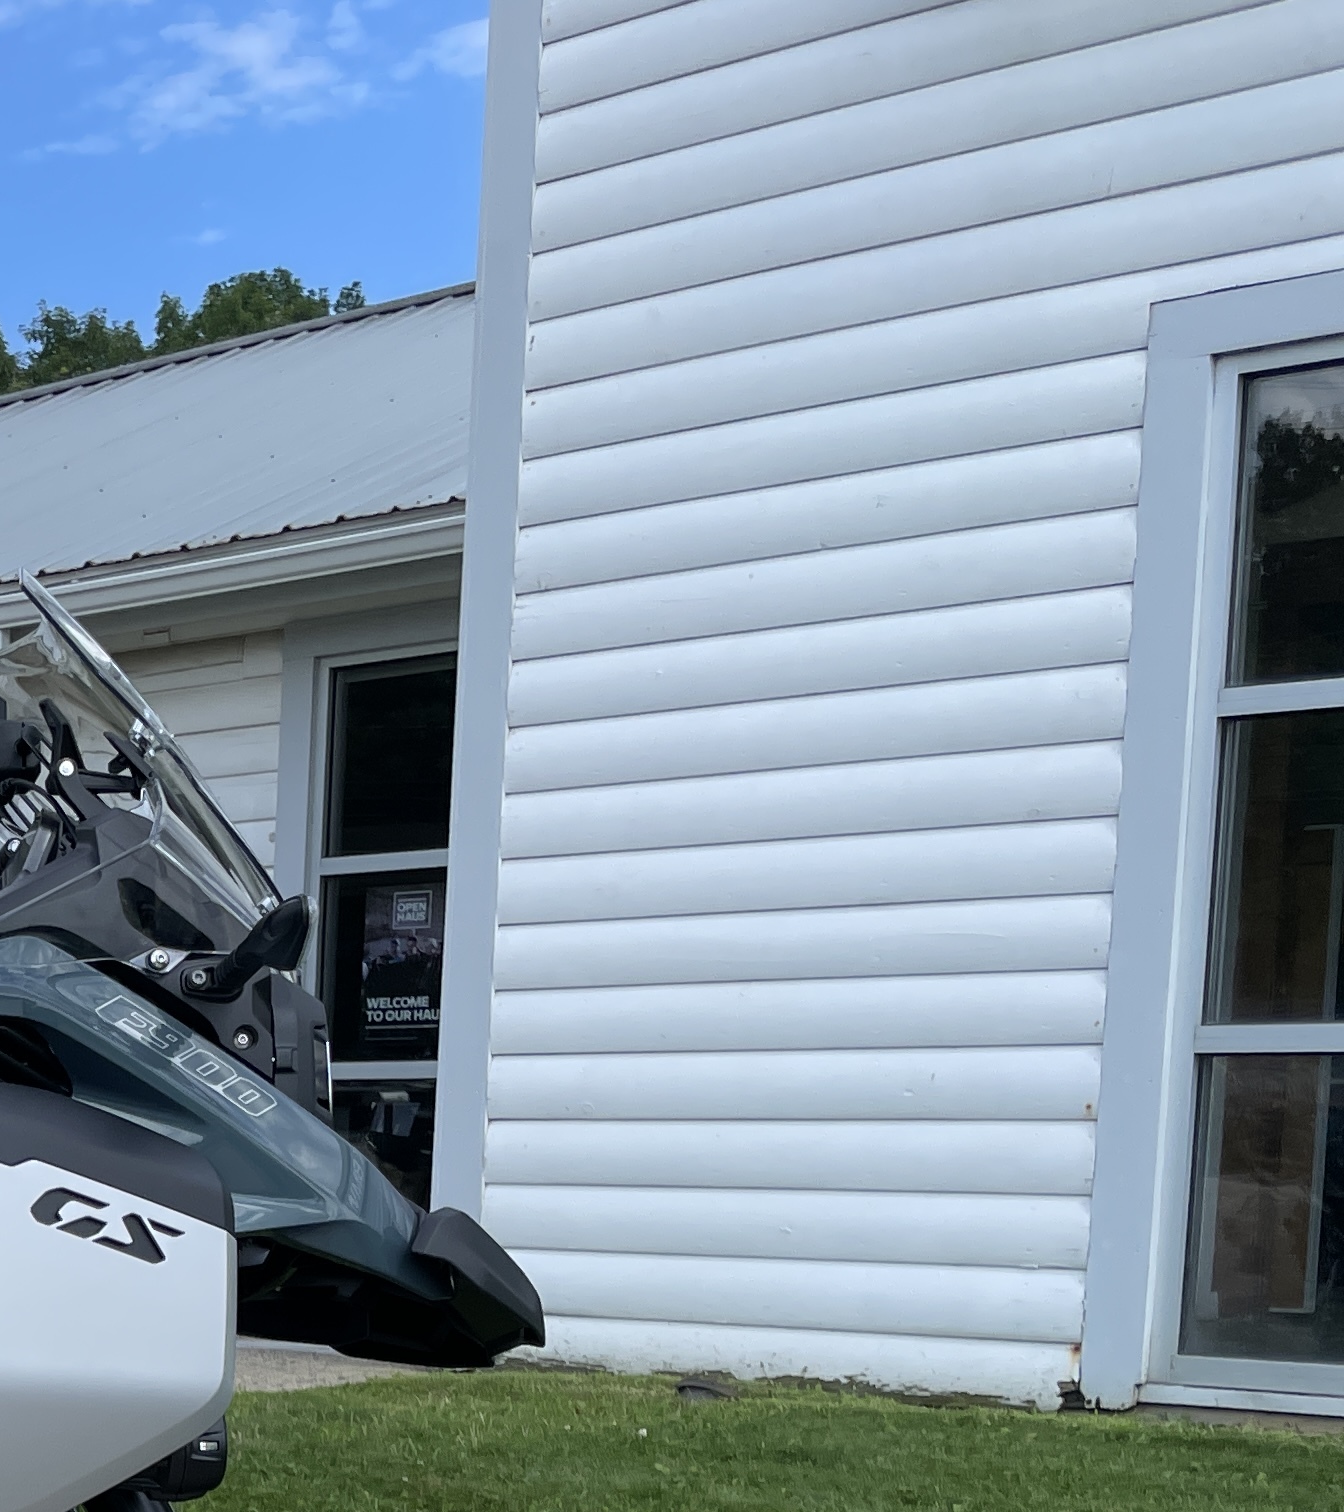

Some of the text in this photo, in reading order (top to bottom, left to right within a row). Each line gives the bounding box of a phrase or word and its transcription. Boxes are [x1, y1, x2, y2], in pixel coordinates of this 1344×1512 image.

[397, 902, 427, 912] OPEN
[397, 912, 426, 921] HAUS
[366, 996, 430, 1009] WELCOME
[366, 1008, 440, 1022] TO OUR HAU
[30, 1187, 185, 1264] GS
